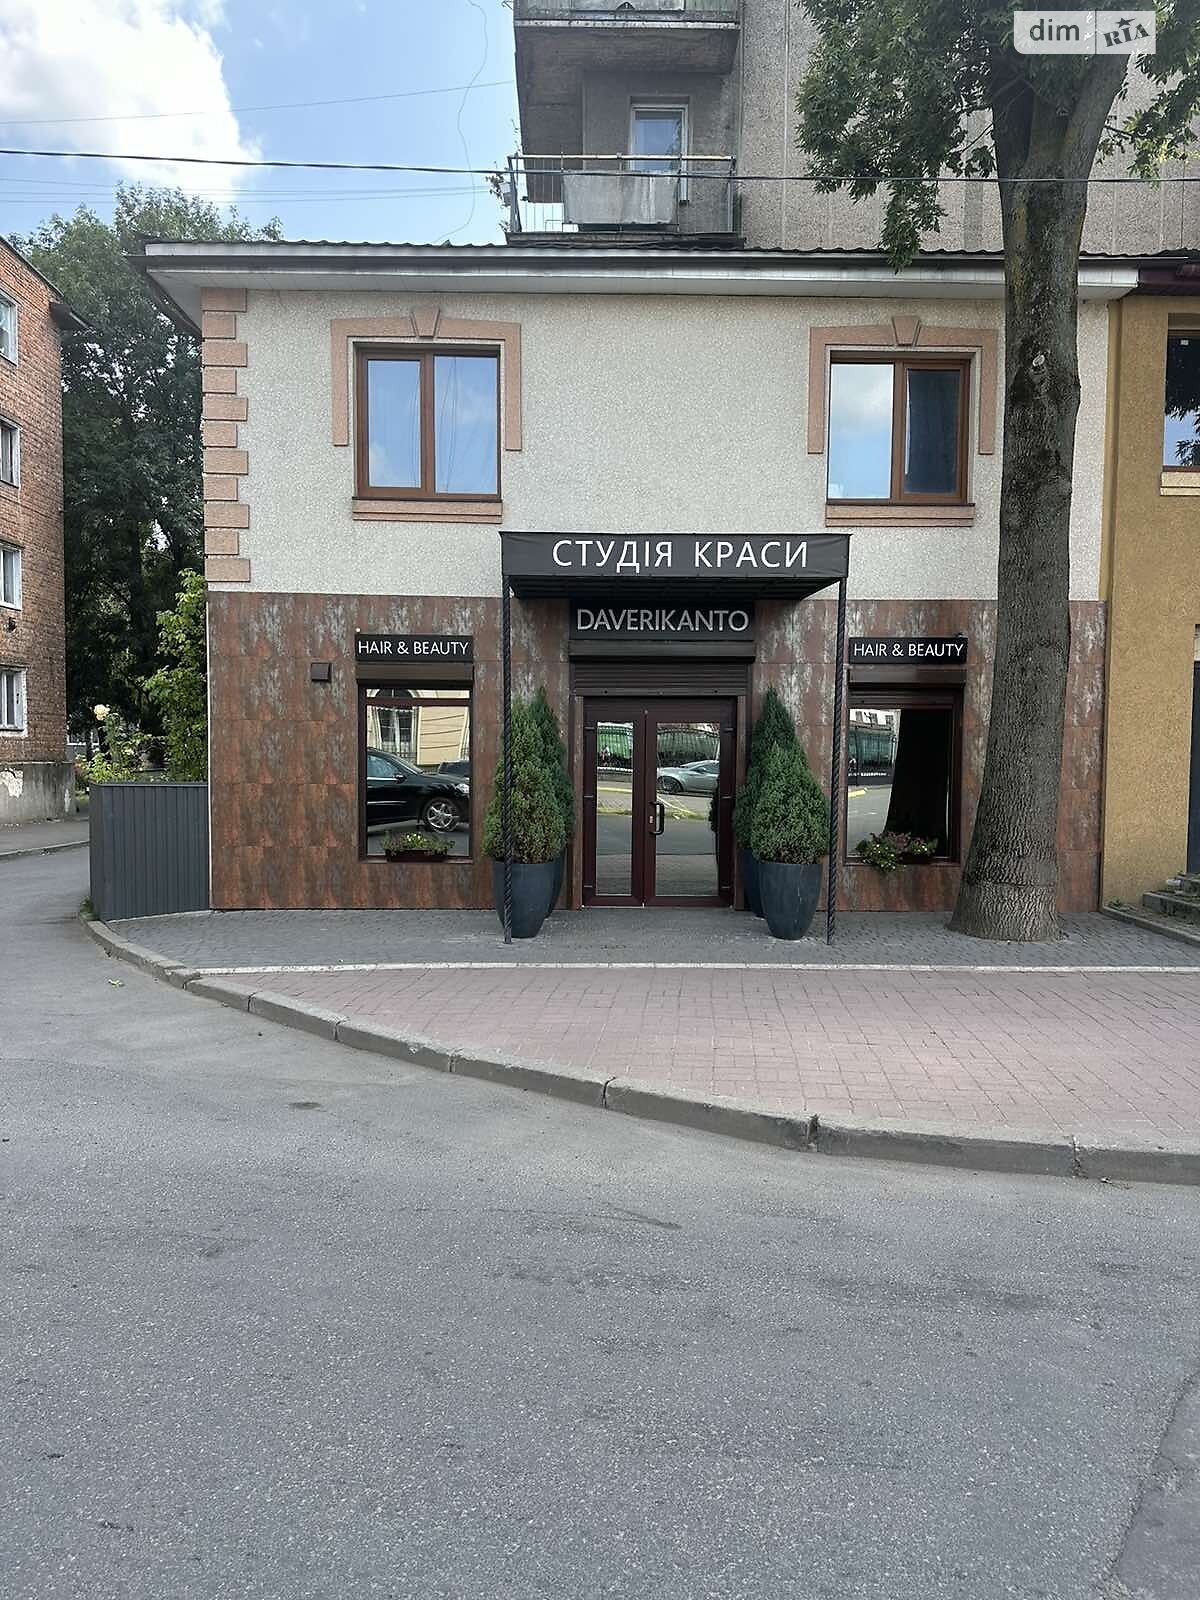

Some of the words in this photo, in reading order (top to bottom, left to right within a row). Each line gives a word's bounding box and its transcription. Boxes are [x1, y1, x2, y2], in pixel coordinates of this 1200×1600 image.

[551, 539, 673, 574] СТУДІЯ
[694, 540, 808, 569] КРАСИ
[576, 608, 750, 632] DAVERIKANTO
[358, 640, 393, 655] HAIR
[397, 640, 409, 655] &
[413, 641, 469, 655] BEAUTY
[853, 643, 888, 657] HAIR
[891, 643, 904, 657] &
[908, 643, 964, 657] BEAUTY
